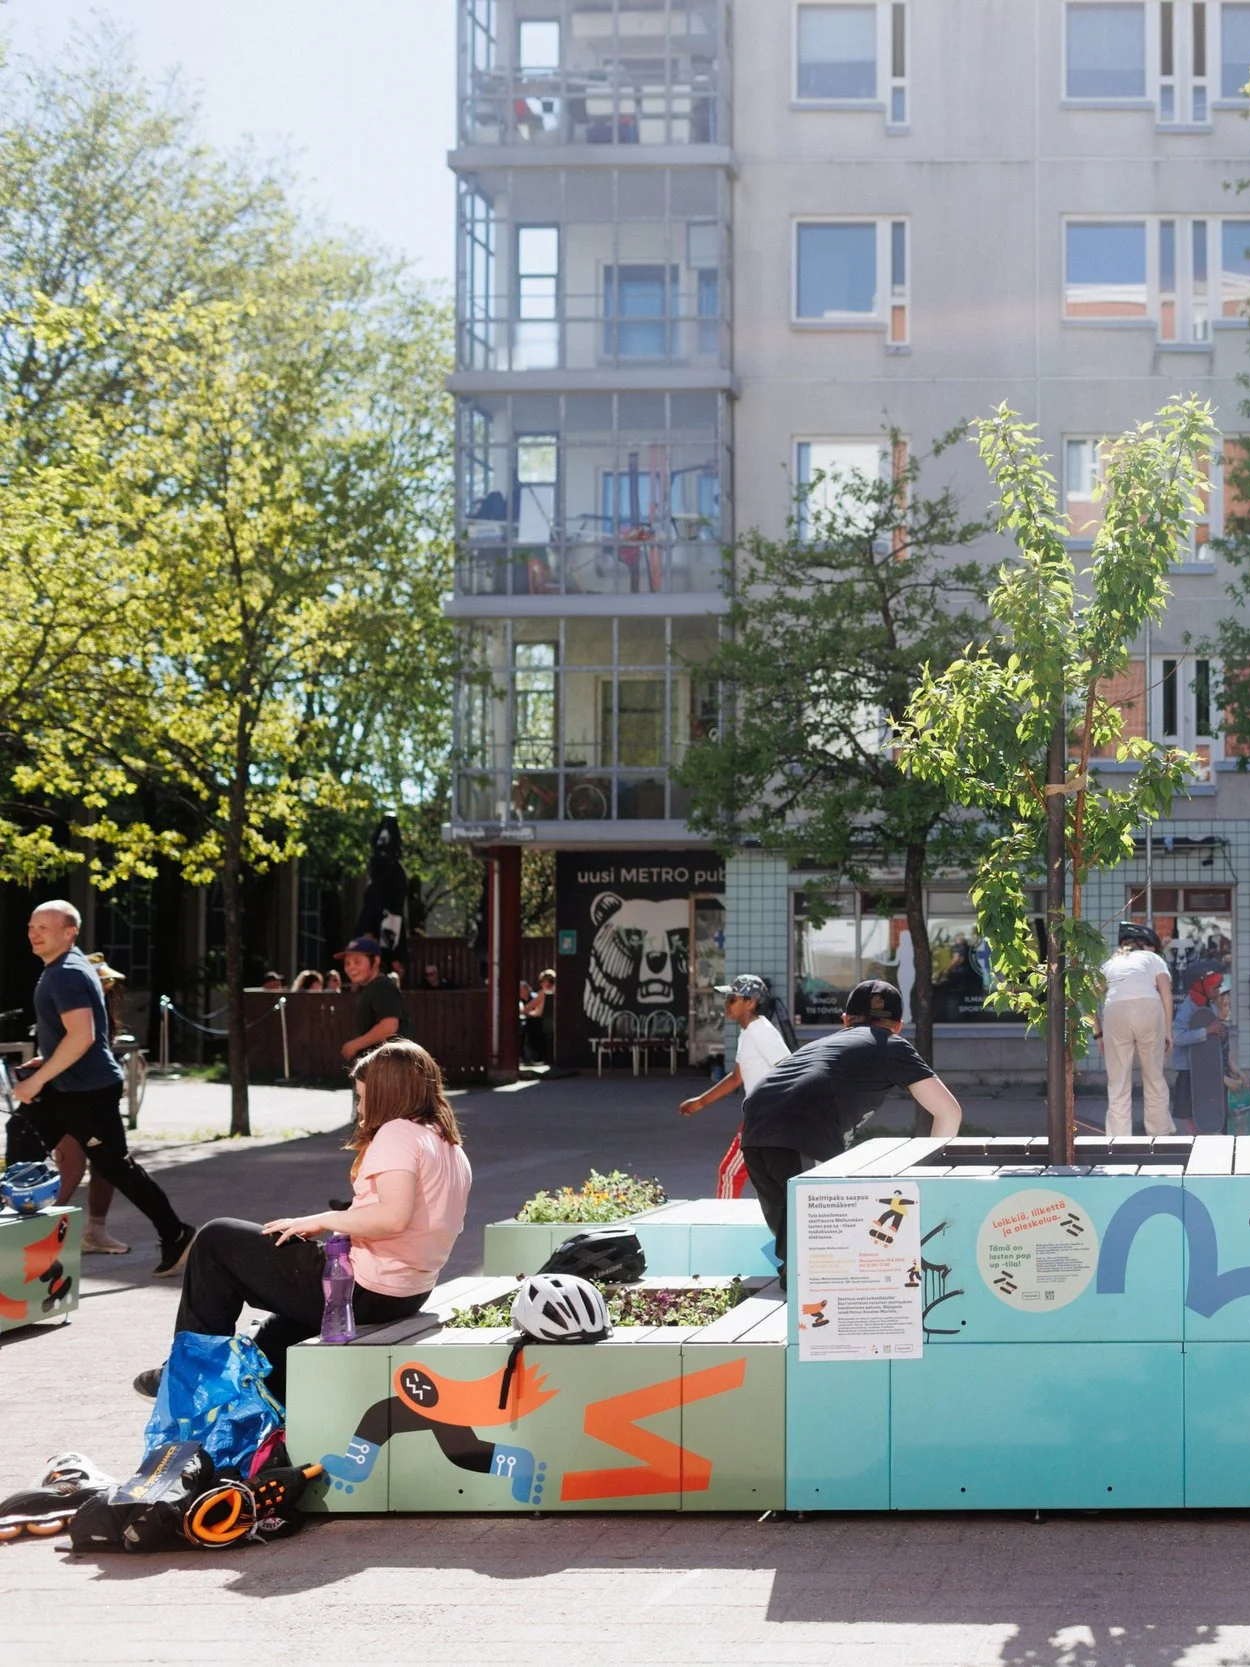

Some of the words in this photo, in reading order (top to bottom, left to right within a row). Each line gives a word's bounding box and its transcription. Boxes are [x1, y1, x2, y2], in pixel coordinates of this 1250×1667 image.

[577, 867, 615, 883] uusi
[620, 867, 689, 883] METRO
[694, 867, 725, 886] pub
[992, 1211, 1030, 1228] Leikkiä,
[1031, 1200, 1066, 1217] liikettä
[1002, 1228, 1013, 1238] ja
